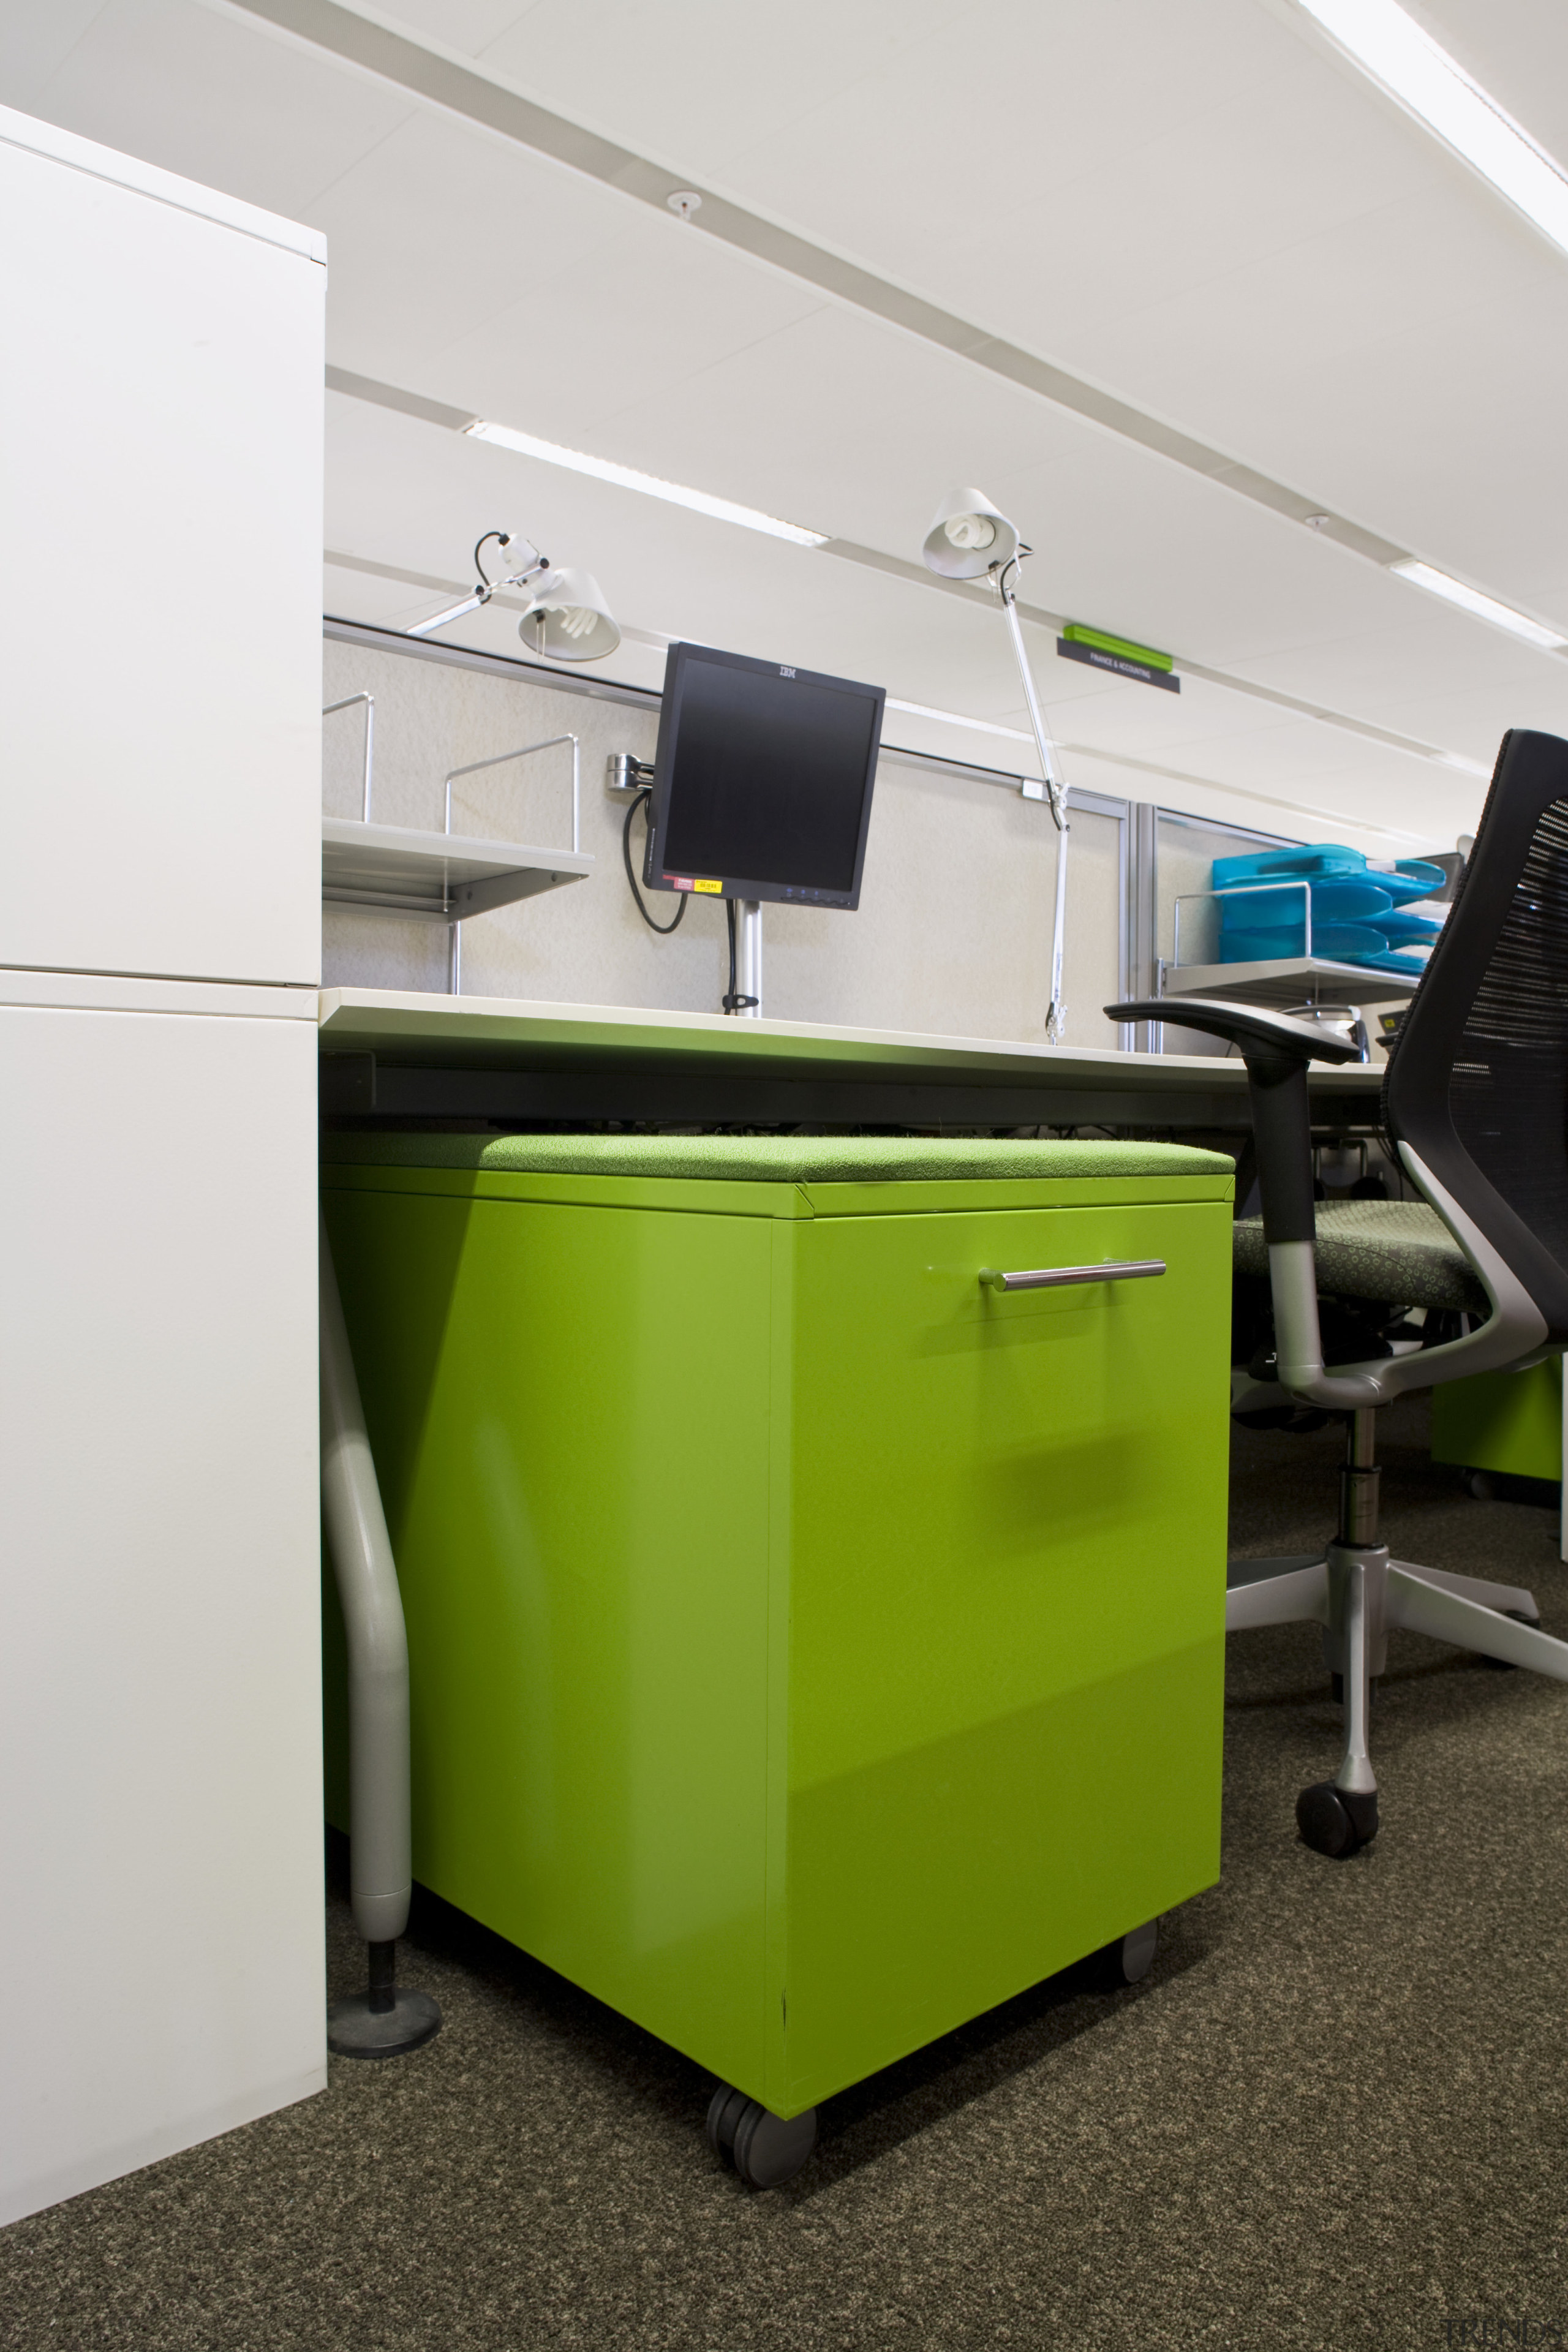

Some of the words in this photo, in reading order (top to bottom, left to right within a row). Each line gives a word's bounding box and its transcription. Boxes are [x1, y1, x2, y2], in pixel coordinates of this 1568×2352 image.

[780, 666, 796, 679] IBM
[1090, 652, 1112, 667] FINANCE
[1114, 660, 1118, 668] &
[1118, 662, 1151, 679] ACCOUNTING
